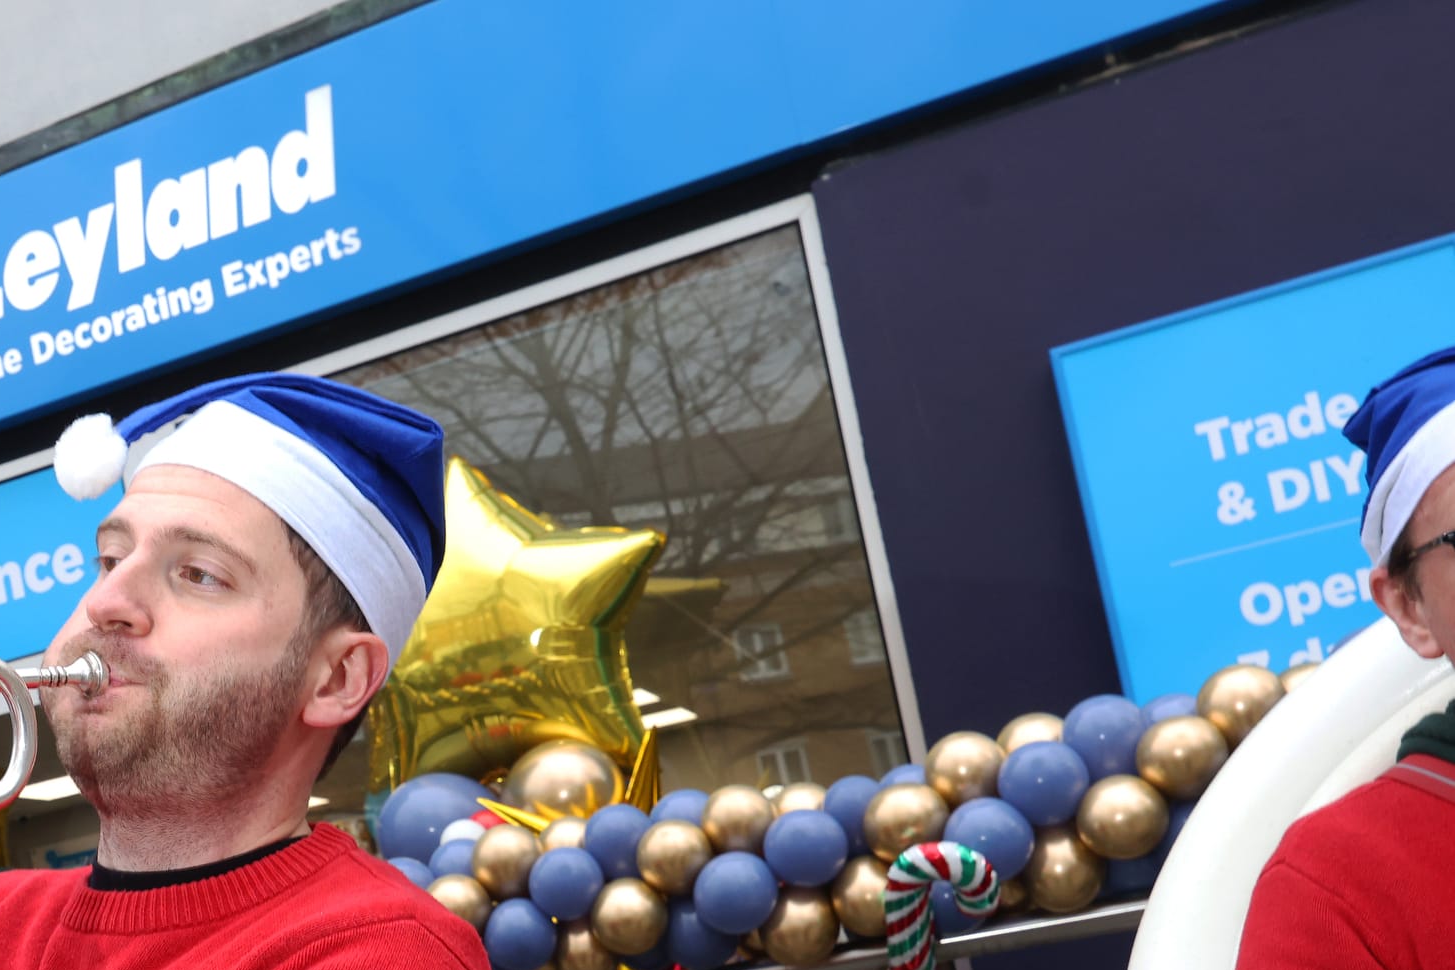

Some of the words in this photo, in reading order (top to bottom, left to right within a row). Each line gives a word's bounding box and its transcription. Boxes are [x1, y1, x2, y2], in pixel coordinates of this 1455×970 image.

[29, 278, 213, 365] Decorating
[221, 226, 362, 298] Experts
[1193, 390, 1359, 462] Trade
[1216, 480, 1257, 526] &
[1266, 450, 1364, 514] DIY
